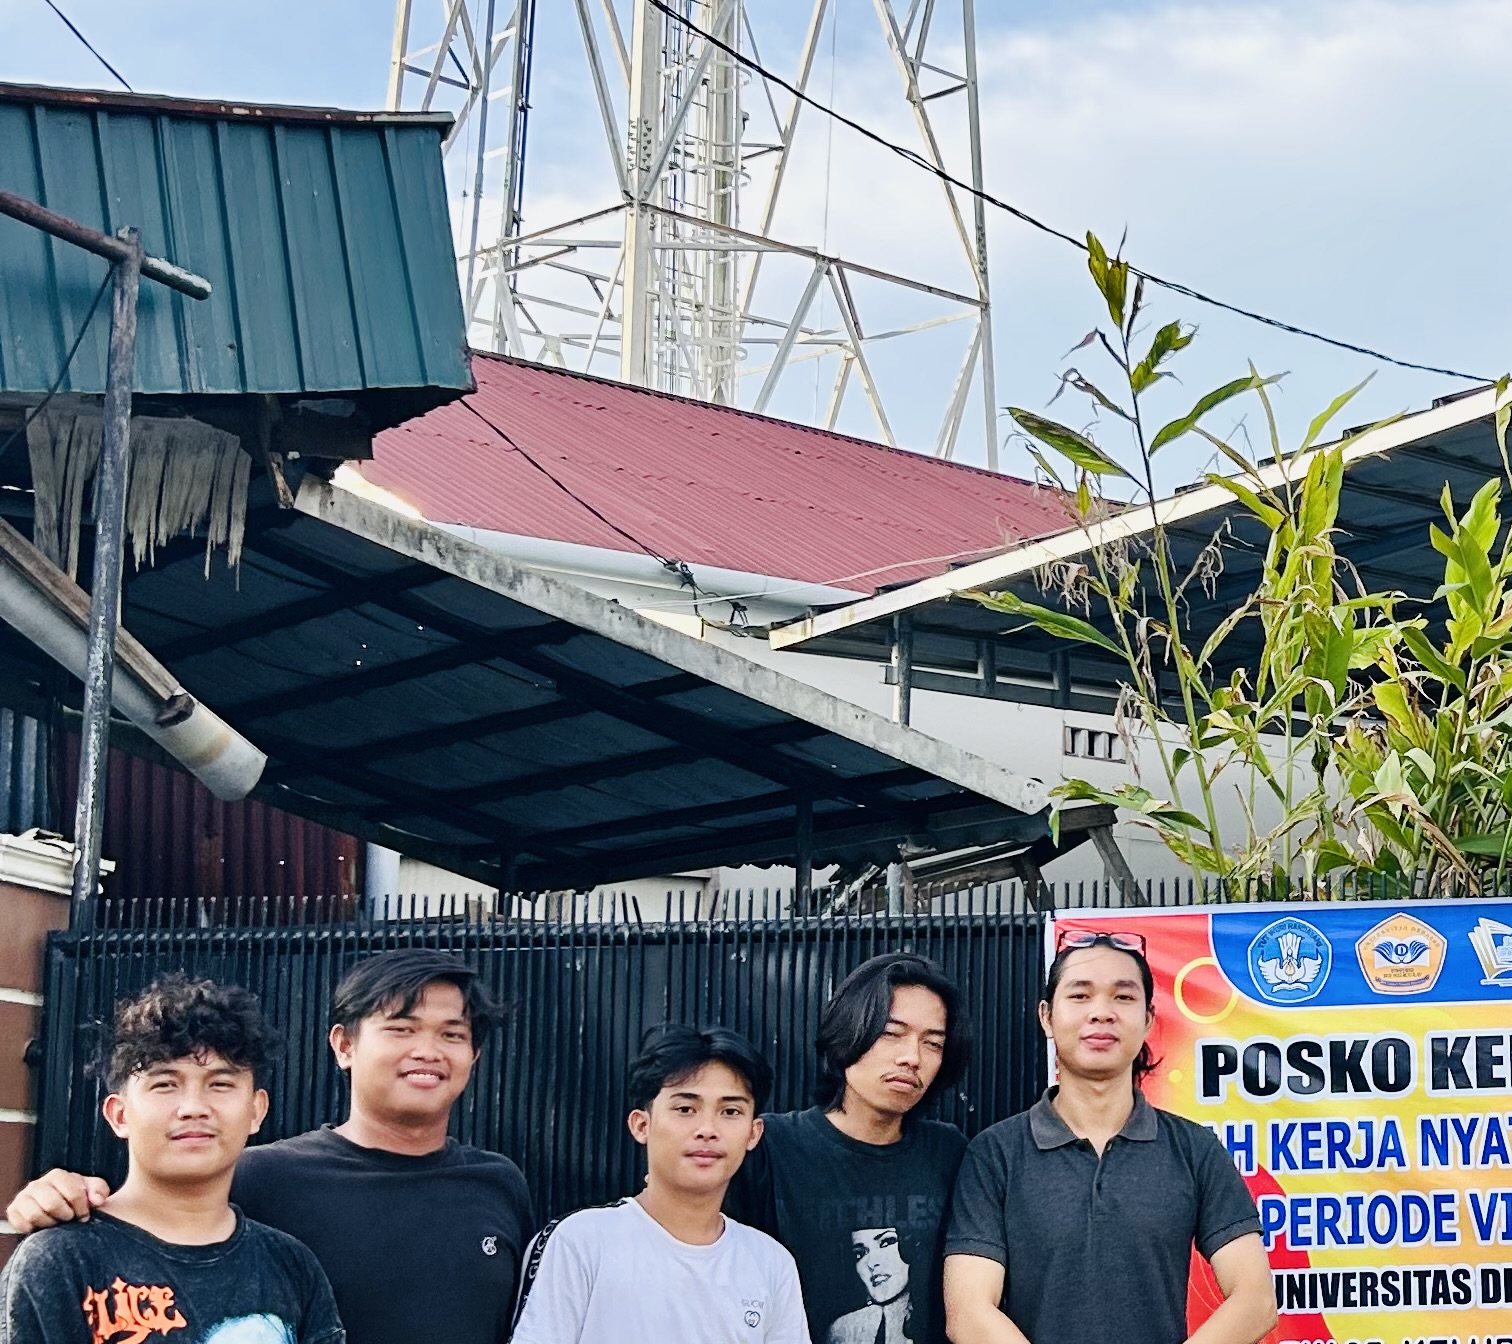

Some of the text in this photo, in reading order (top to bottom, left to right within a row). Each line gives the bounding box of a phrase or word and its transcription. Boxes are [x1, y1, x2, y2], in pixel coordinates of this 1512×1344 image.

[1202, 1037, 1411, 1097] POSKO
[1271, 1120, 1406, 1171] KERJA
[1261, 1194, 1457, 1247] PERIODE
